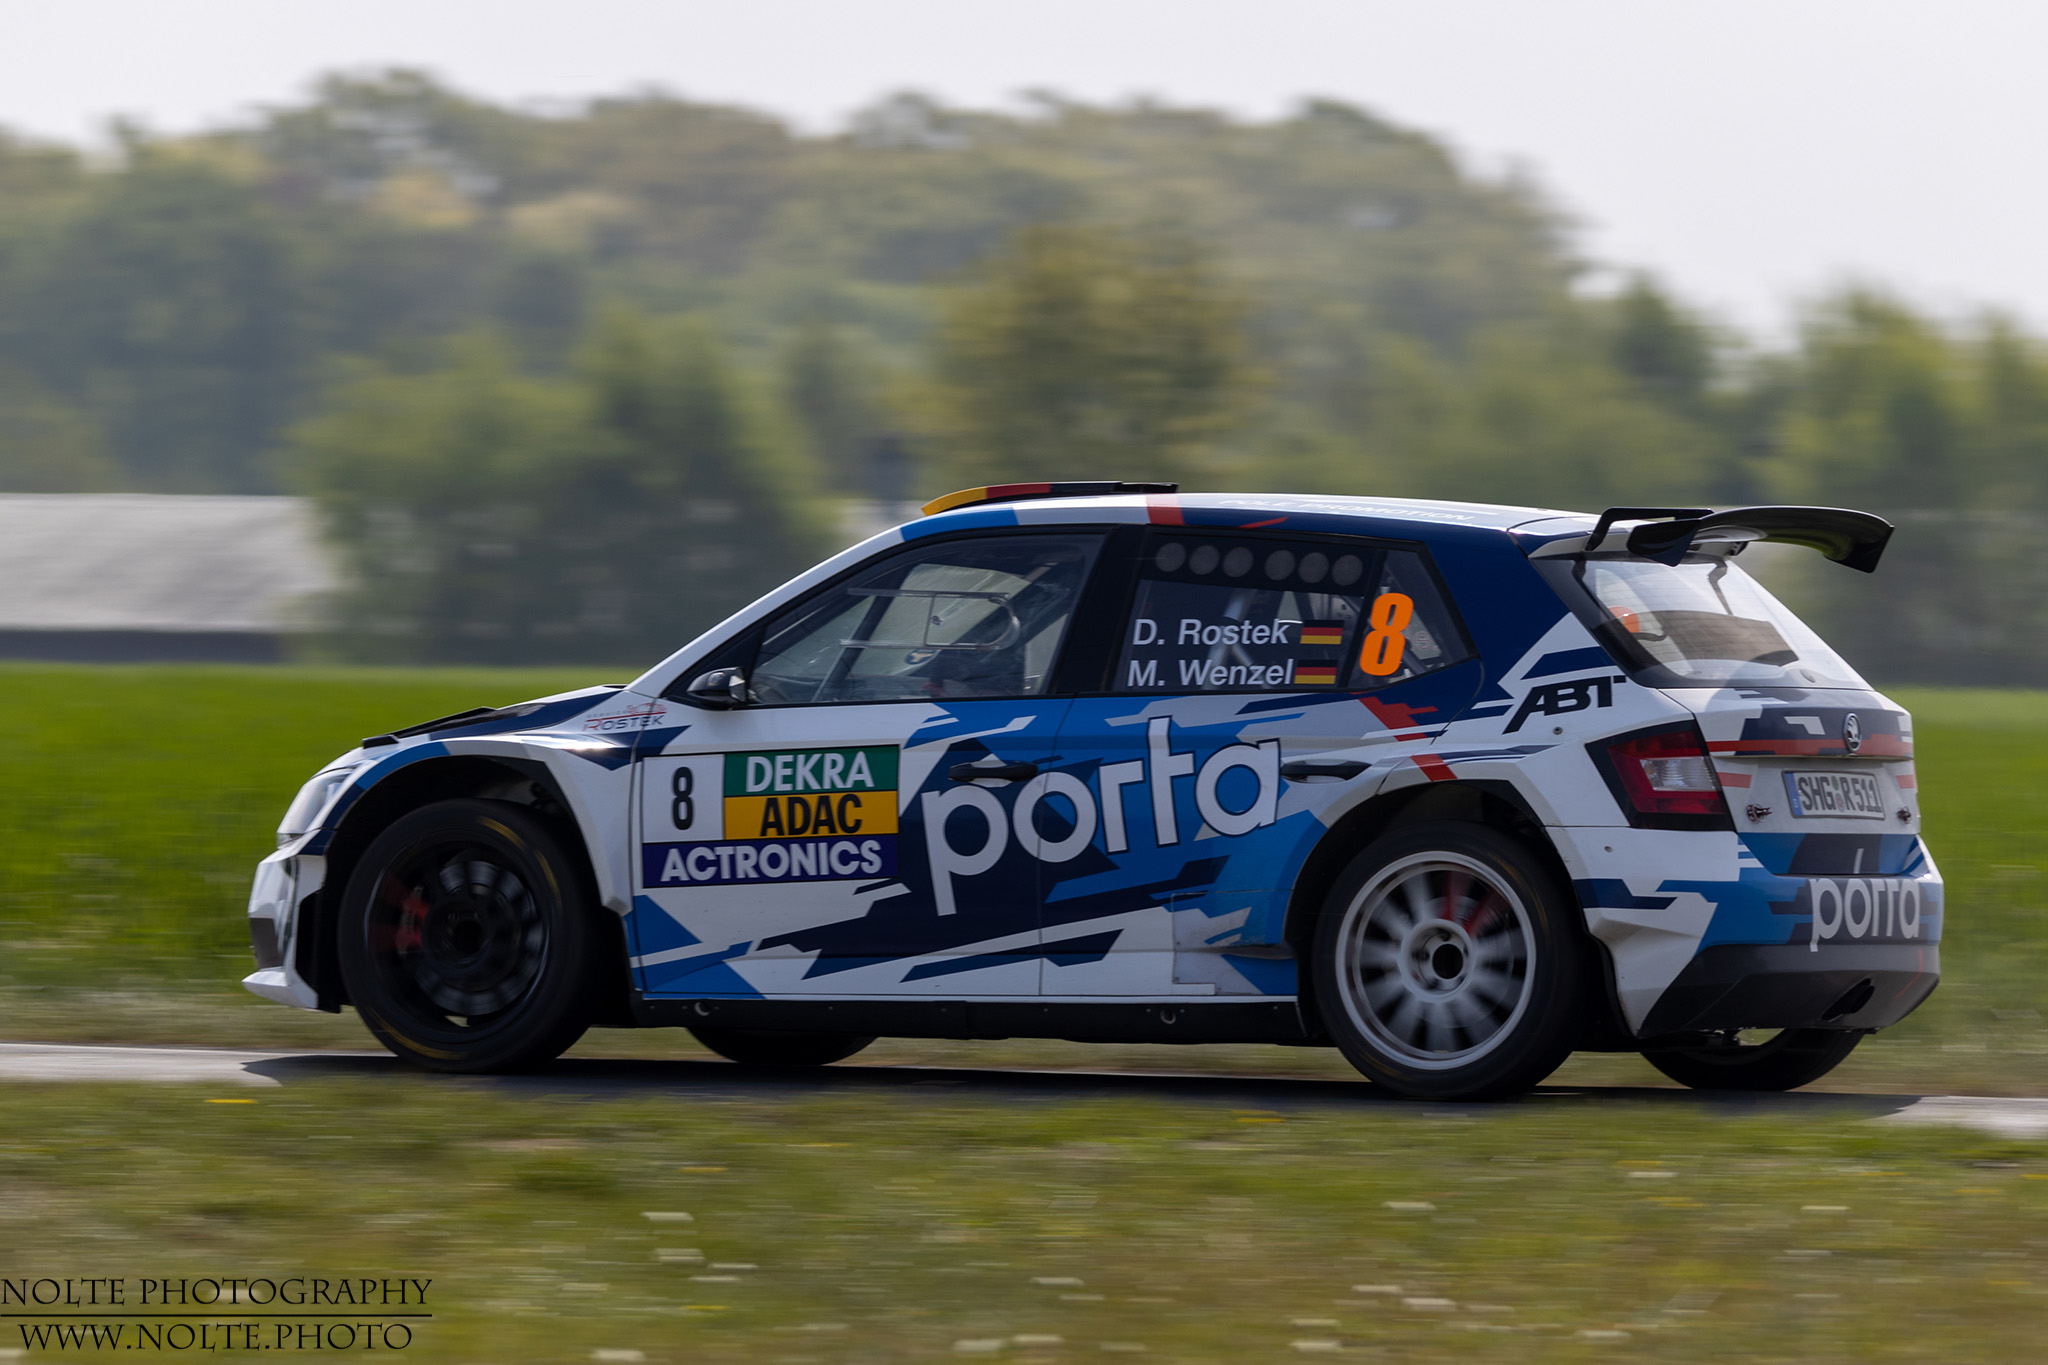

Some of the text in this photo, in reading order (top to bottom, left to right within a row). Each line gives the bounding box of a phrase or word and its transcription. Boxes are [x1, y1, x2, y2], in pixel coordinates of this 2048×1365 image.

[1132, 618, 1289, 646] D. Rostek
[1359, 592, 1414, 677] 8
[1127, 658, 1294, 687] M. Wenzel
[582, 715, 665, 731] ROSTEK
[1501, 675, 1627, 735] ABT
[745, 751, 875, 793] DEKRA
[1798, 776, 1837, 811] SHG
[672, 766, 695, 831] 8
[760, 793, 862, 837] ADAC
[921, 714, 1280, 917] porta
[660, 840, 883, 882] ACTRONICS
[1808, 848, 1921, 952] porta
